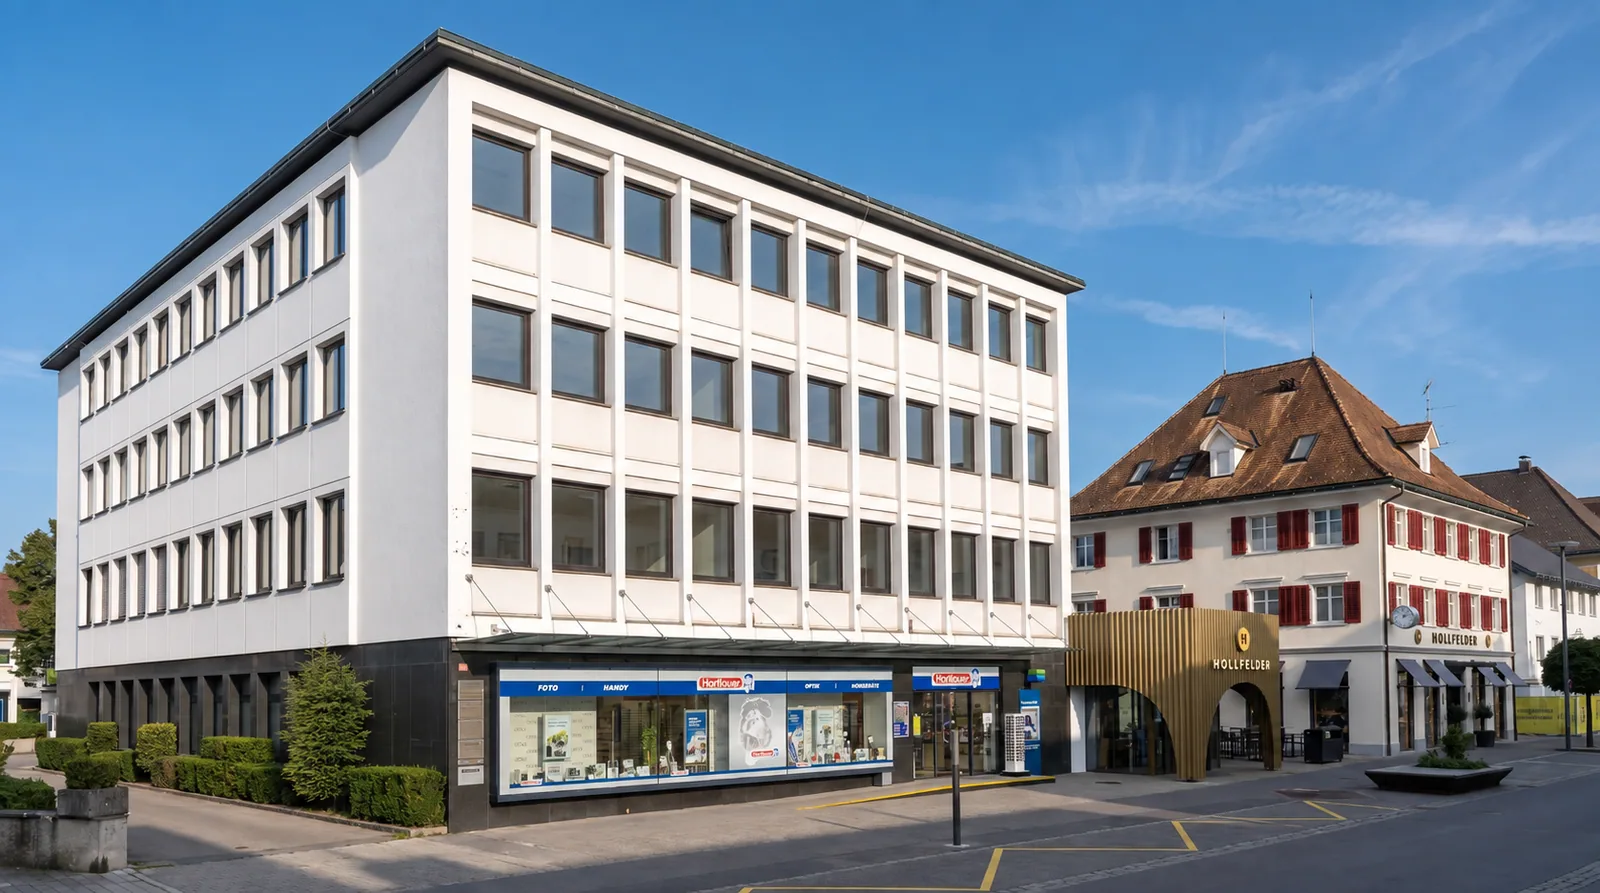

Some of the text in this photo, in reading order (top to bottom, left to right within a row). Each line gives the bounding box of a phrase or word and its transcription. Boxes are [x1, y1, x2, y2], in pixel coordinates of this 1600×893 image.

[1241, 633, 1247, 645] H
[1431, 632, 1478, 646] HOLLFELDER
[1213, 659, 1270, 670] HOLLFELDER
[537, 684, 559, 692] FOTO
